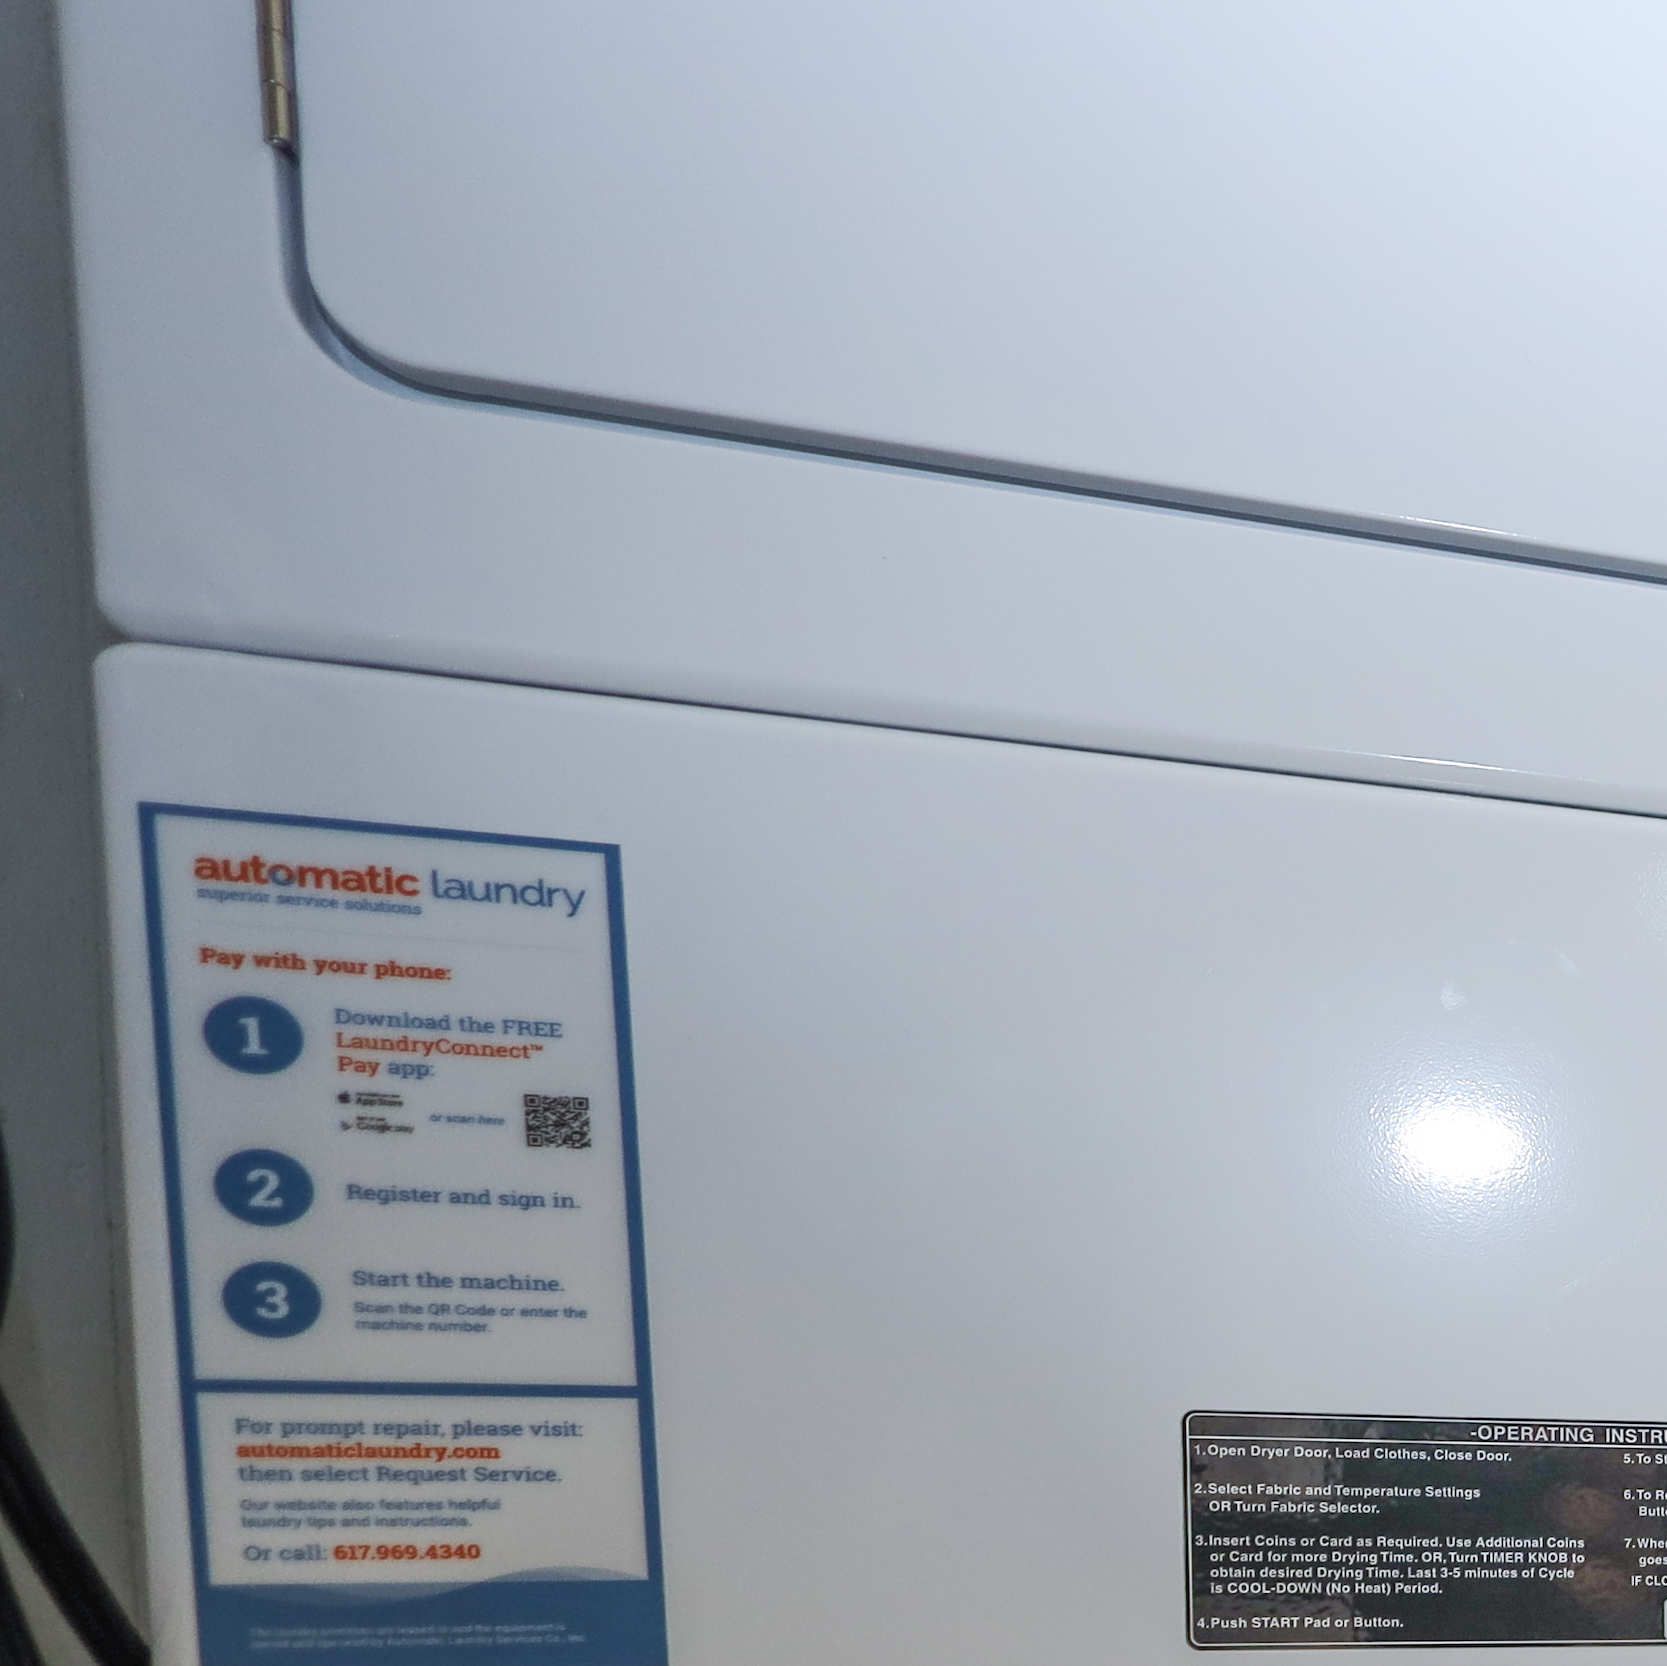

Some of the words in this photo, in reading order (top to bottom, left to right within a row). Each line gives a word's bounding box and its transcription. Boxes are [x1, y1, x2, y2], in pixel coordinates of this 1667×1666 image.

[194, 855, 420, 897] automatic
[431, 869, 586, 917] laundry
[199, 947, 246, 970] Pay
[252, 951, 306, 970] with
[313, 959, 368, 975] your
[374, 959, 452, 981] phone:
[334, 1007, 451, 1031] Download
[458, 1016, 495, 1033] the
[502, 1019, 563, 1038] FREE
[238, 1016, 268, 1056] 1
[337, 1056, 380, 1077] Pay
[387, 1062, 434, 1079] app:
[246, 1169, 282, 1207] 2
[346, 1184, 441, 1204] Register
[449, 1189, 492, 1206] and
[499, 1193, 545, 1210] sign
[552, 1191, 581, 1209] in.
[352, 1271, 410, 1288] Start
[416, 1272, 453, 1289] the
[461, 1274, 565, 1292] machine.
[255, 1281, 290, 1319] 3
[236, 1418, 272, 1435] For
[280, 1420, 365, 1440] prompt
[372, 1420, 445, 1439] repair,
[452, 1421, 523, 1439] please
[529, 1422, 583, 1437] visit:
[236, 1443, 500, 1463] automaticlaundry.com
[1251, 1445, 1290, 1459] Dryer
[1336, 1447, 1370, 1458] Load
[1374, 1447, 1431, 1461] Clothes,
[1434, 1450, 1472, 1461] Close
[1477, 1450, 1512, 1462] Door.
[238, 1465, 292, 1482] then
[300, 1465, 368, 1482] select
[377, 1466, 466, 1485] Request
[474, 1466, 562, 1482] Service.
[1257, 1484, 1300, 1496] Fabric
[1305, 1484, 1331, 1496] and
[1334, 1485, 1421, 1498] Temperature
[1425, 1486, 1481, 1500] Settings
[243, 1545, 273, 1561] Or
[279, 1545, 328, 1561] call:
[333, 1544, 481, 1561] 617.969.4340
[1251, 1617, 1300, 1629] START
[1304, 1617, 1330, 1629] Pad
[1334, 1619, 1349, 1628] or
[1353, 1616, 1404, 1629] Button.
